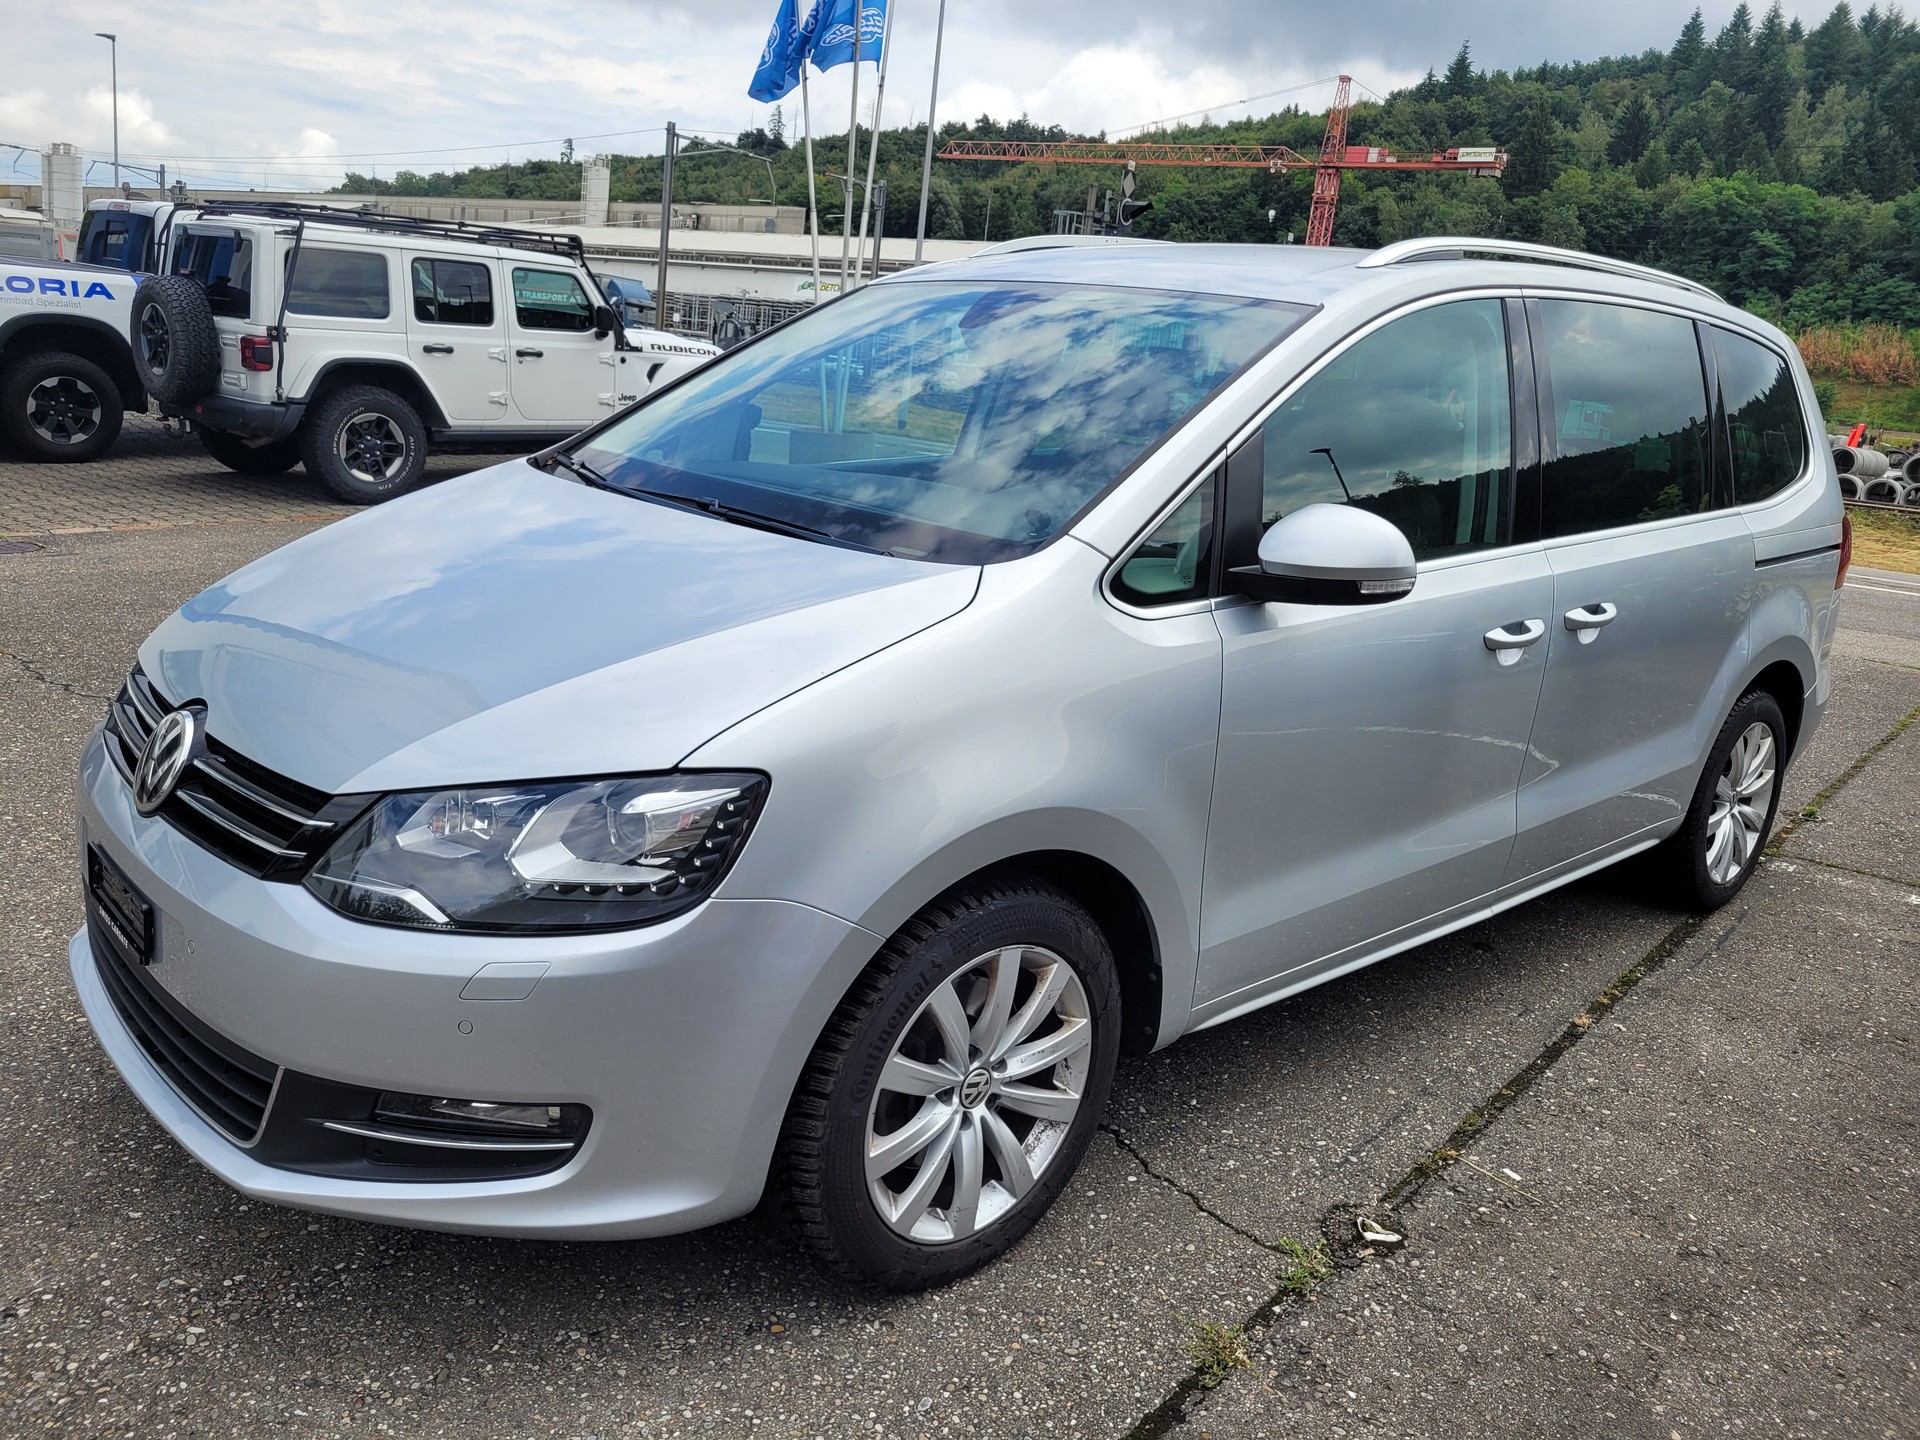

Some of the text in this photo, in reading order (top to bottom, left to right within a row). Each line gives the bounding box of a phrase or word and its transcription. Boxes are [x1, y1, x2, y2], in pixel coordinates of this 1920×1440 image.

[0, 275, 116, 300] ORIA
[521, 290, 569, 302] TRANSPORT
[36, 297, 82, 309] Spezialist
[650, 343, 717, 356] RUBICON
[618, 393, 637, 402] Jeep
[849, 971, 932, 1104] Continental
